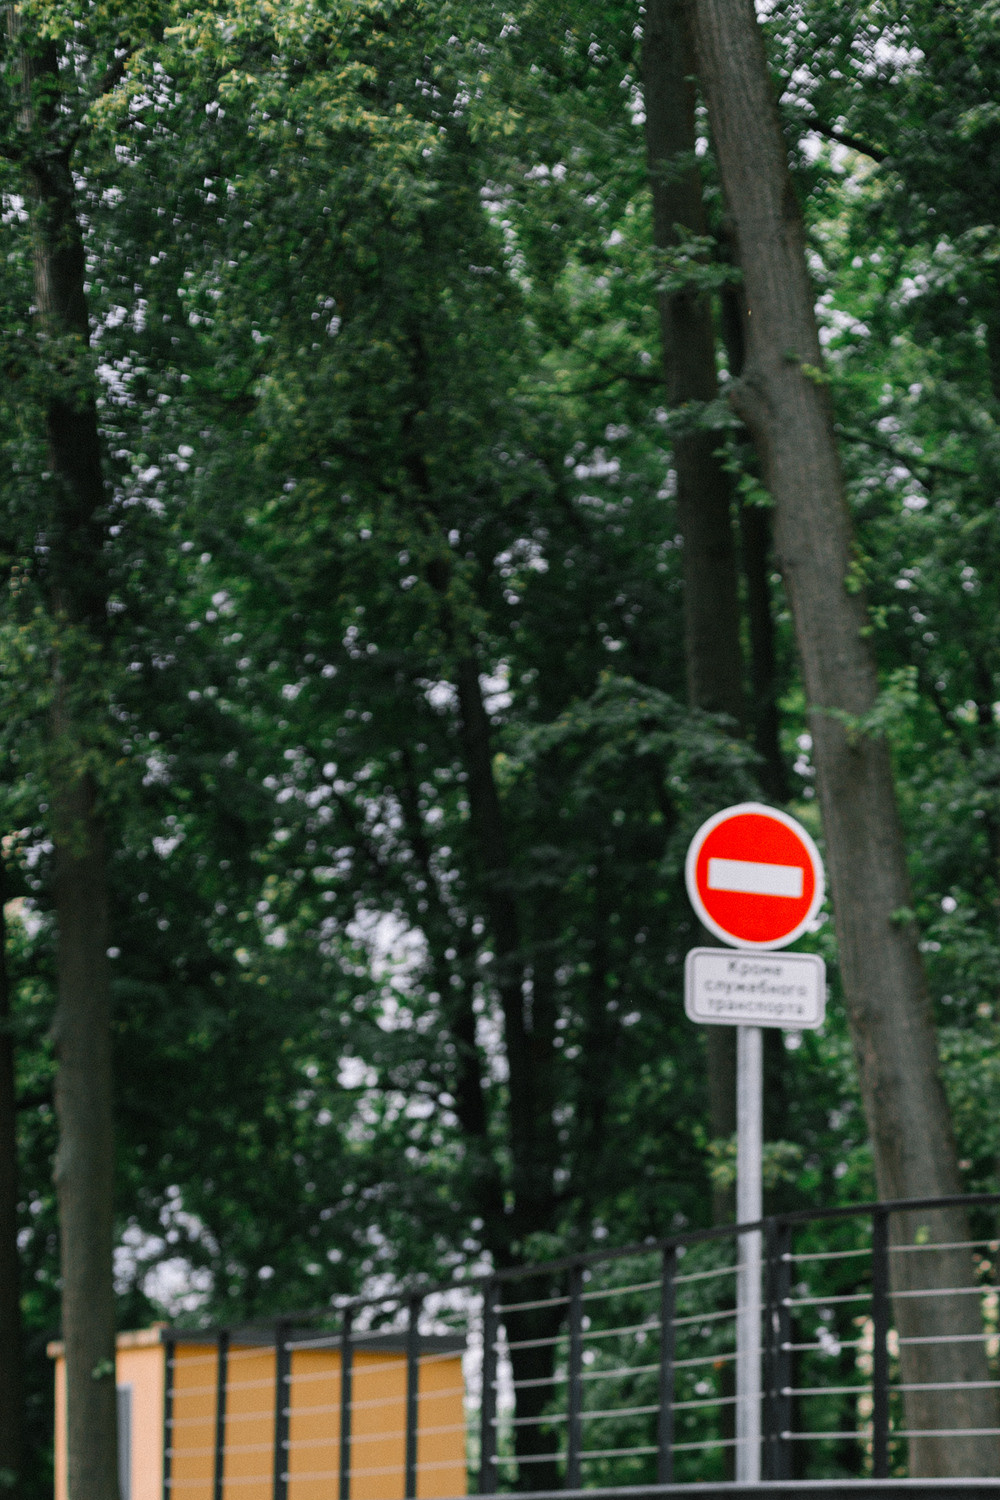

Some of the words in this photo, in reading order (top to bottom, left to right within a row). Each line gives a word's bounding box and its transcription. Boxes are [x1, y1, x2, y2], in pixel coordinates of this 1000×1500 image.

[728, 960, 782, 976] Кроме
[704, 980, 807, 996] служебного
[708, 998, 804, 1015] транспорта
